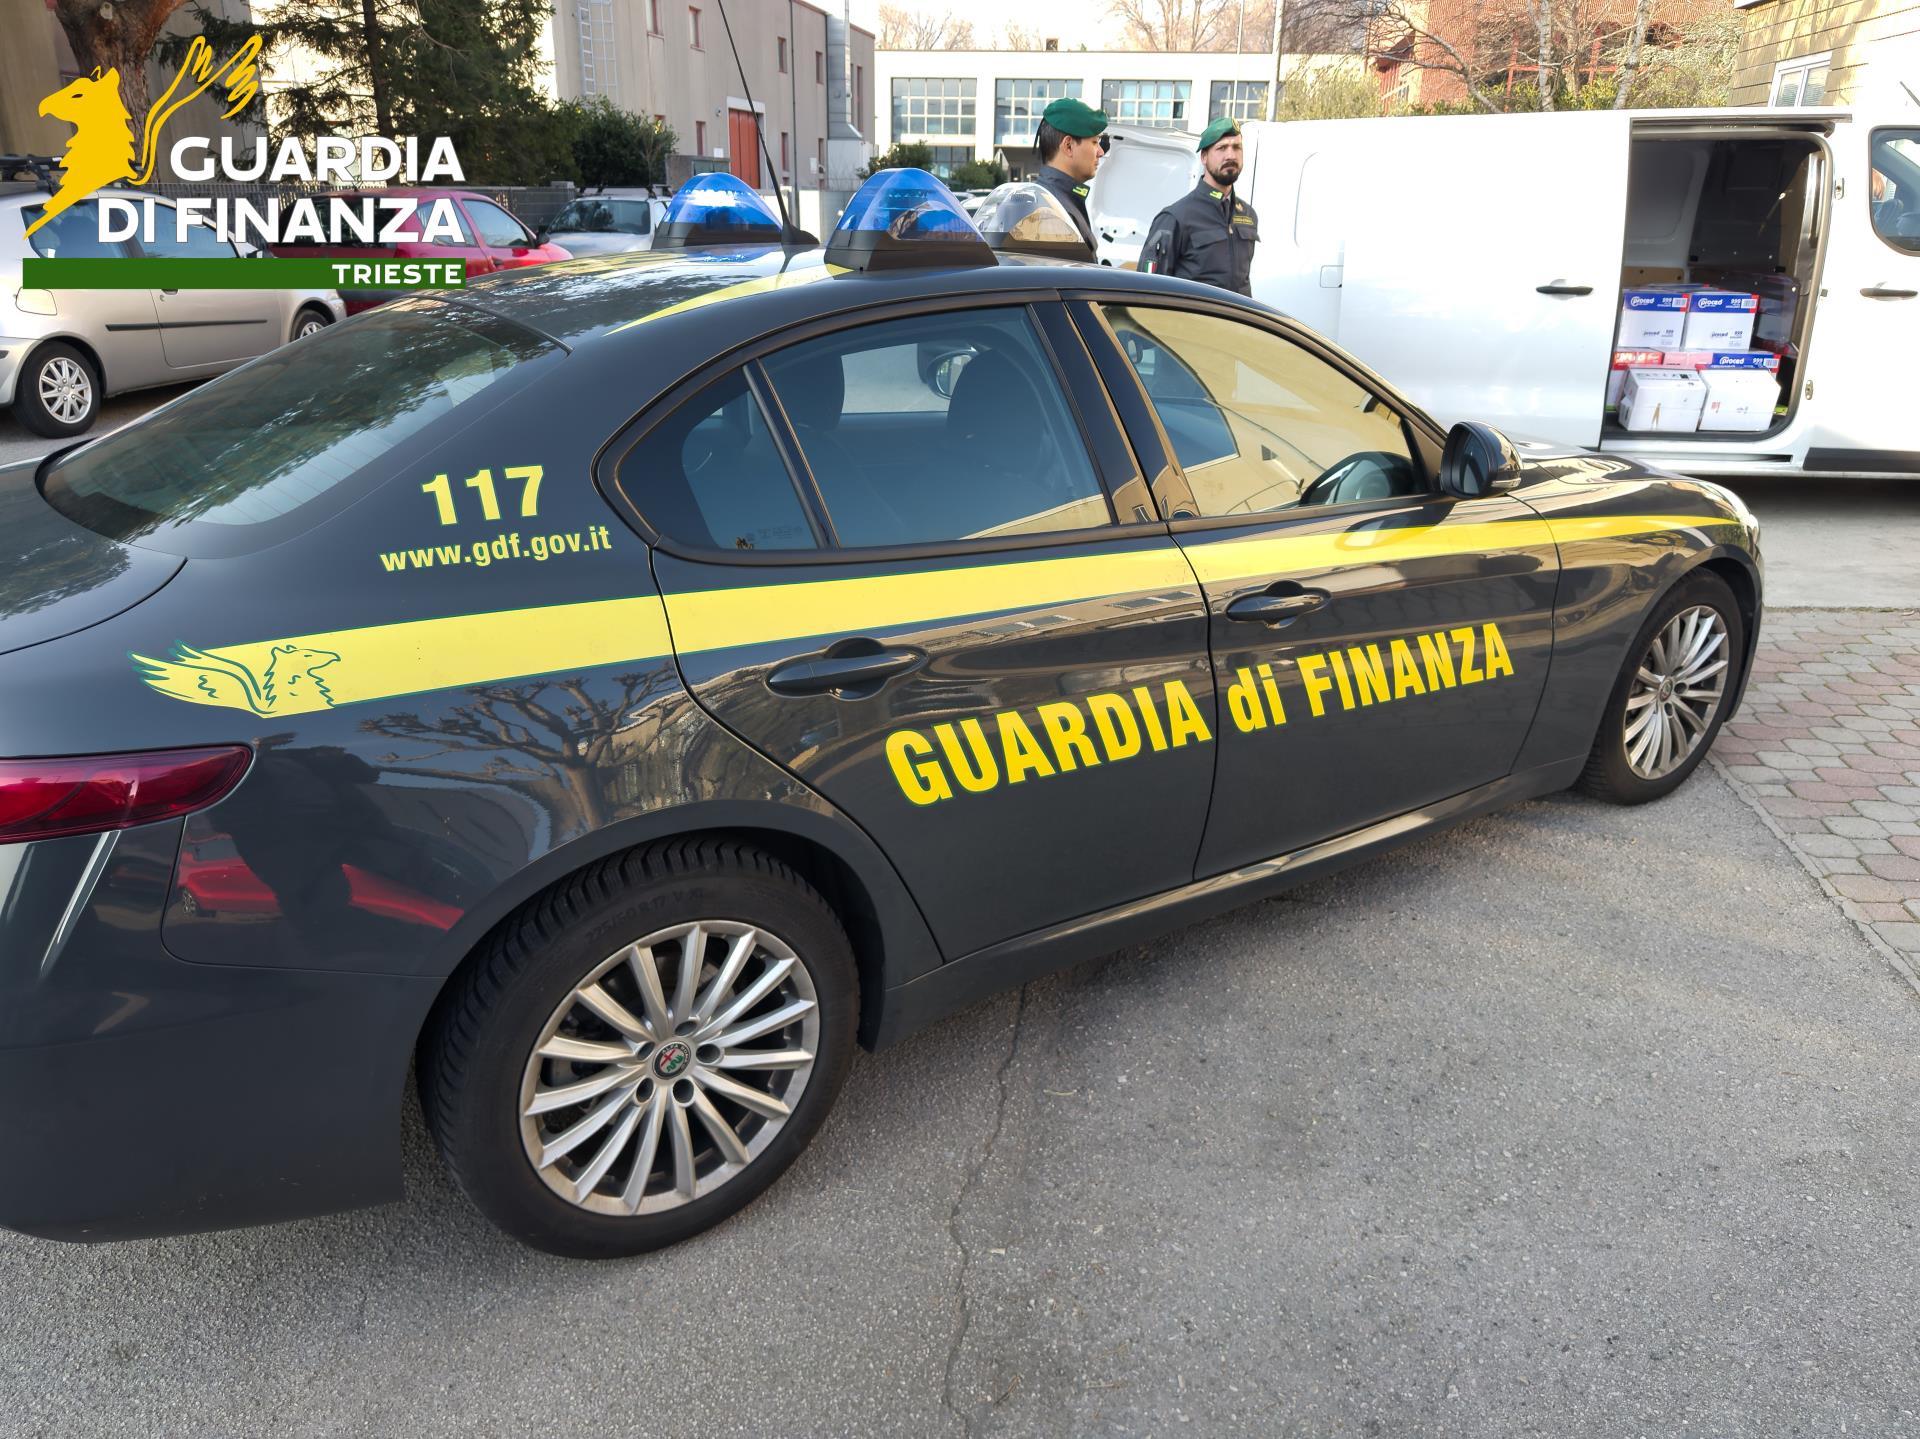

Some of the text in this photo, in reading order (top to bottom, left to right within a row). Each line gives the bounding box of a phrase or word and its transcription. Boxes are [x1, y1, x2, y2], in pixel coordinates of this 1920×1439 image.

[422, 465, 544, 525] 117
[380, 525, 612, 572] www.gdf.gov.it
[885, 622, 1514, 806] GUARDIA di FINANZA
